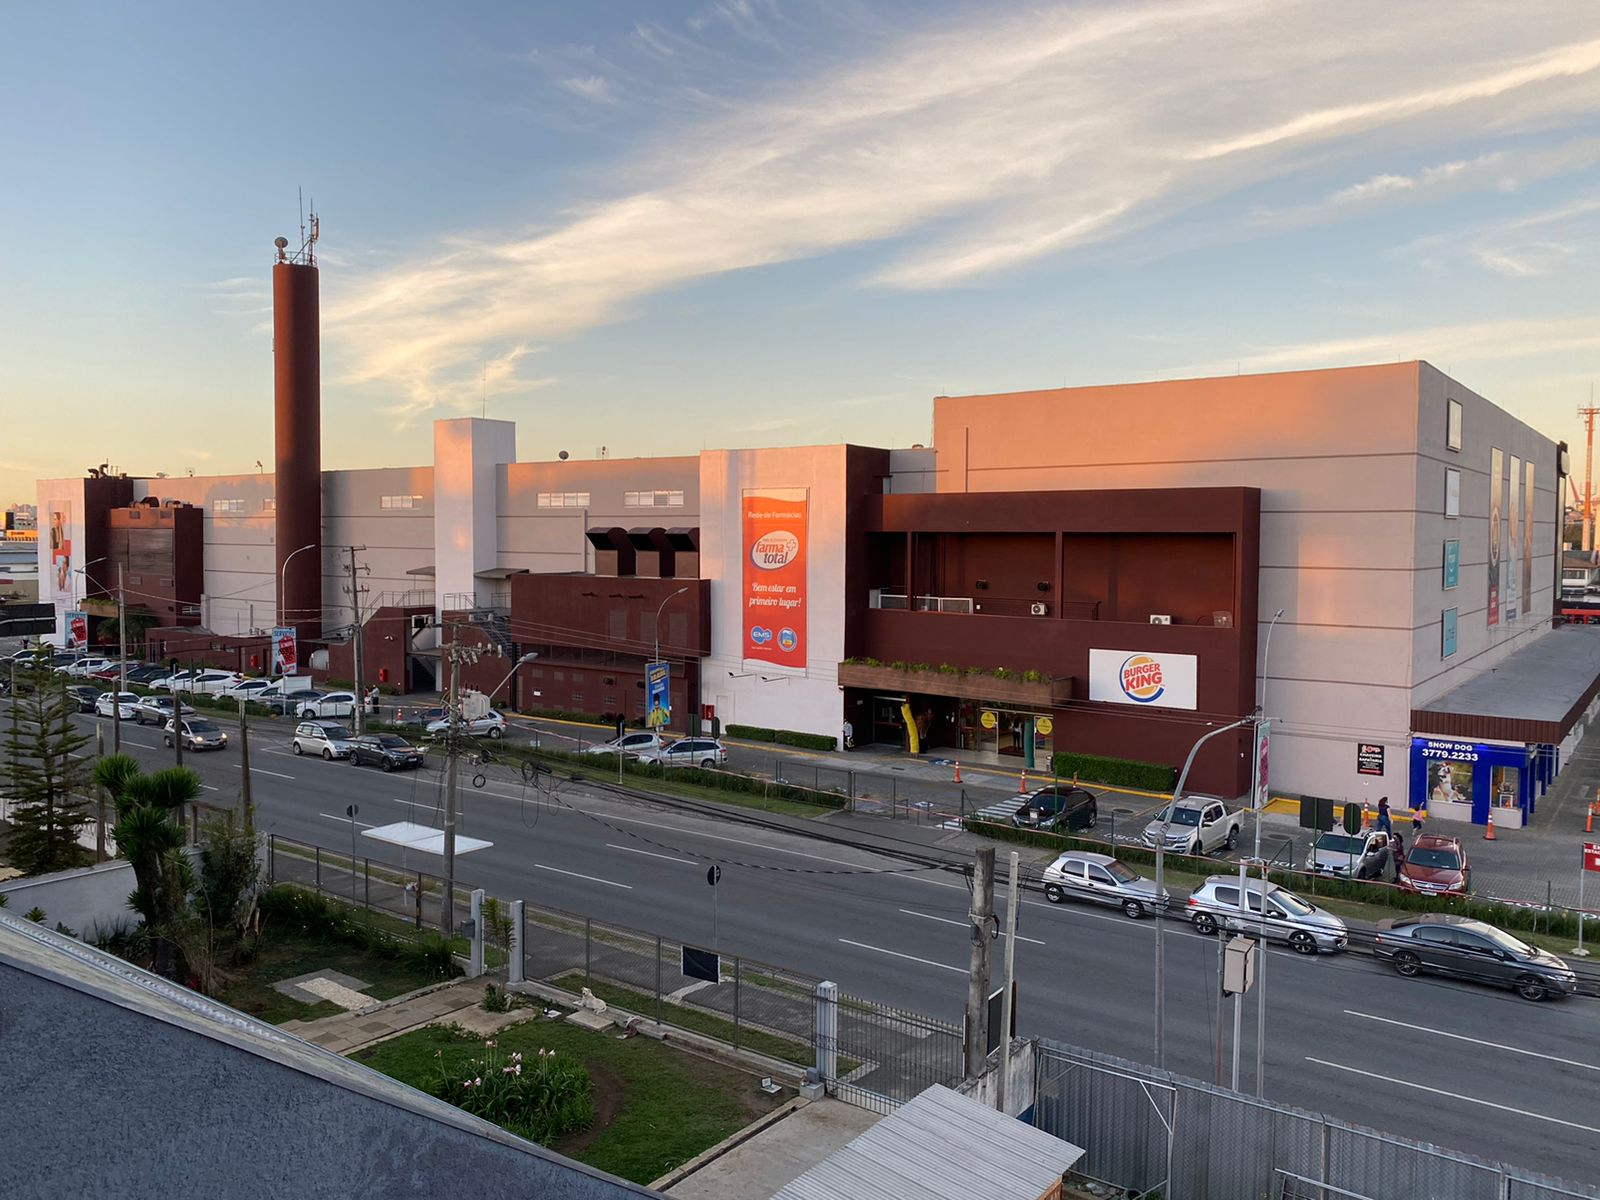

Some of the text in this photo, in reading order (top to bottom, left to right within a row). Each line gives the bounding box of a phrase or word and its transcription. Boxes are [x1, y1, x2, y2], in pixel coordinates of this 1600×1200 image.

[756, 541, 784, 553] farma
[763, 552, 789, 564] total
[752, 582, 767, 592] Bem
[768, 584, 785, 593] estar
[749, 597, 802, 610] primeiro lugar!
[1124, 663, 1161, 679] BURGER
[1125, 672, 1162, 691] KING
[1428, 741, 1453, 750] SNOW
[1422, 748, 1479, 761] 3779.2233
